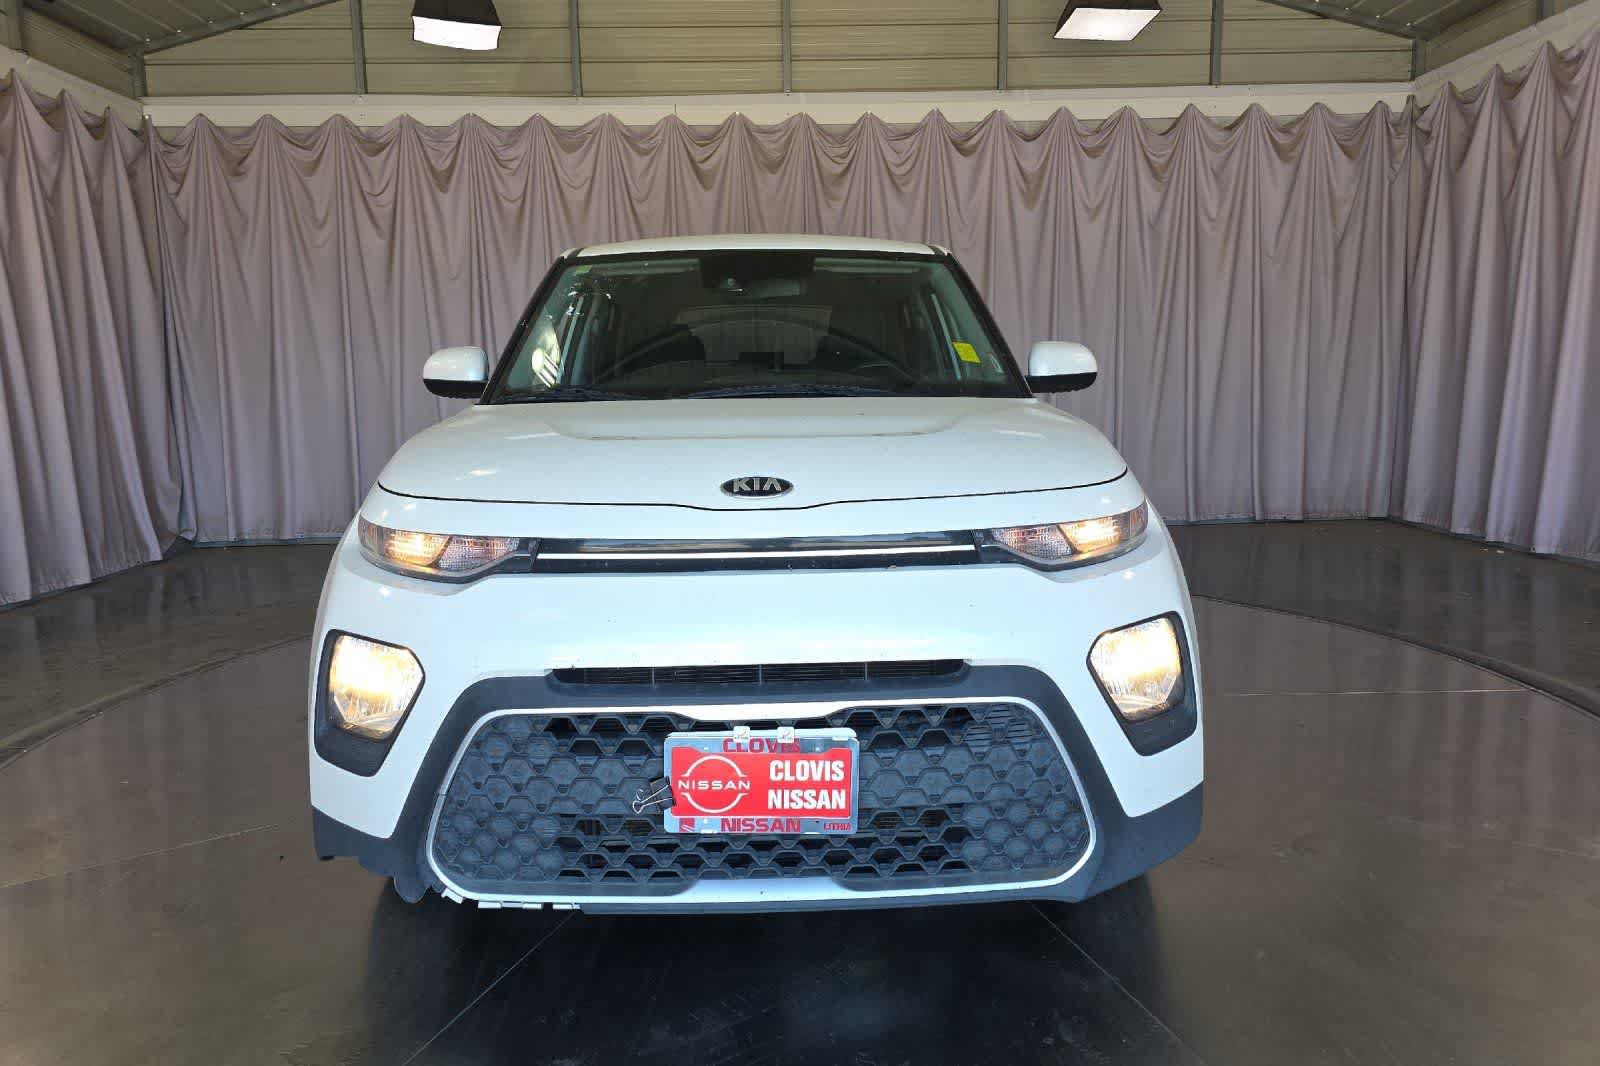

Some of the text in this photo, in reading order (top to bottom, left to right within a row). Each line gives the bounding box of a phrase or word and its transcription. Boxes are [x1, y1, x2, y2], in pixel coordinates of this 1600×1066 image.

[733, 478, 782, 492] KIA
[769, 759, 844, 782] CLOVIS
[678, 780, 750, 790] NISSAN
[768, 788, 846, 810] NISSAN
[720, 818, 801, 832] NISSAN
